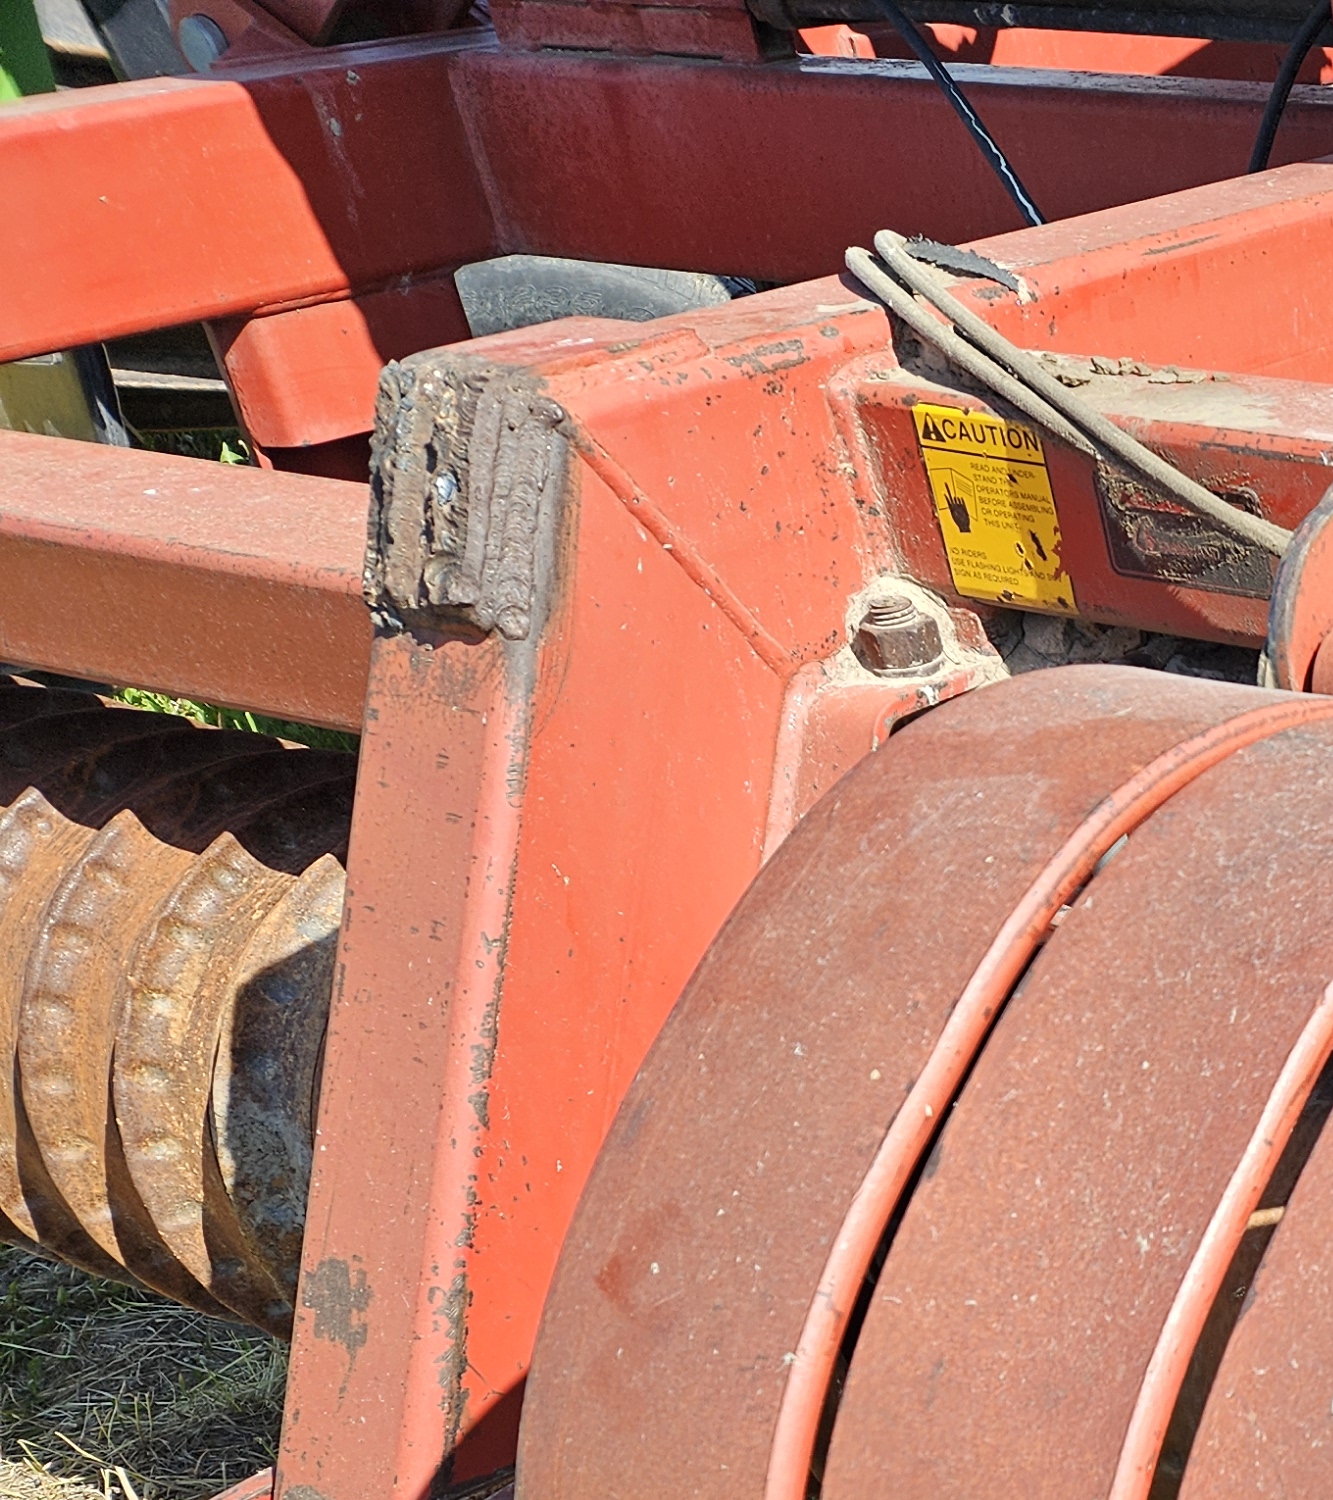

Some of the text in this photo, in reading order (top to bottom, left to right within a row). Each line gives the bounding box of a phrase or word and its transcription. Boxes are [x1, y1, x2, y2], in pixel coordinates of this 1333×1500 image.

[942, 418, 1039, 452] CAUTION
[970, 462, 990, 472] READ
[992, 466, 1007, 475] AND
[972, 474, 997, 484] STAND
[976, 484, 1052, 504] OPERATORS MANUAL
[978, 496, 1054, 515] BEFORE ASSEMBLING
[981, 507, 1035, 523] OR OPERATING
[984, 518, 1000, 528] THIS
[951, 557, 966, 566] USE
[967, 560, 1001, 572] FLASHING
[1003, 563, 1029, 577] LIGHTS
[954, 568, 971, 578] SIGN
